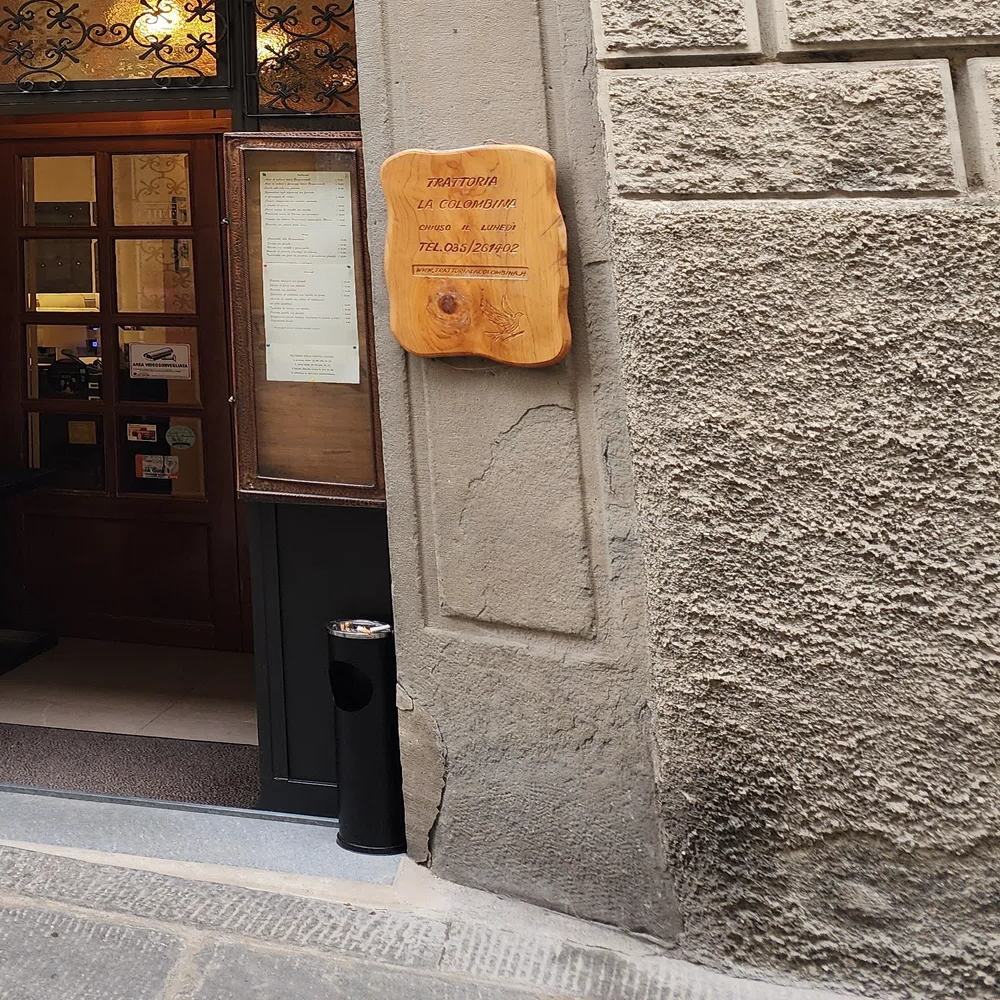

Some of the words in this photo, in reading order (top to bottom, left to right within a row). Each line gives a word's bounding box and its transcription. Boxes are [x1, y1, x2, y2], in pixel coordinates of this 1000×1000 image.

[426, 176, 498, 188] TRATTORIA
[418, 199, 433, 210] LA
[439, 199, 516, 210] COLOMBINA
[418, 224, 451, 232] CHIUSO
[461, 224, 471, 232] IL
